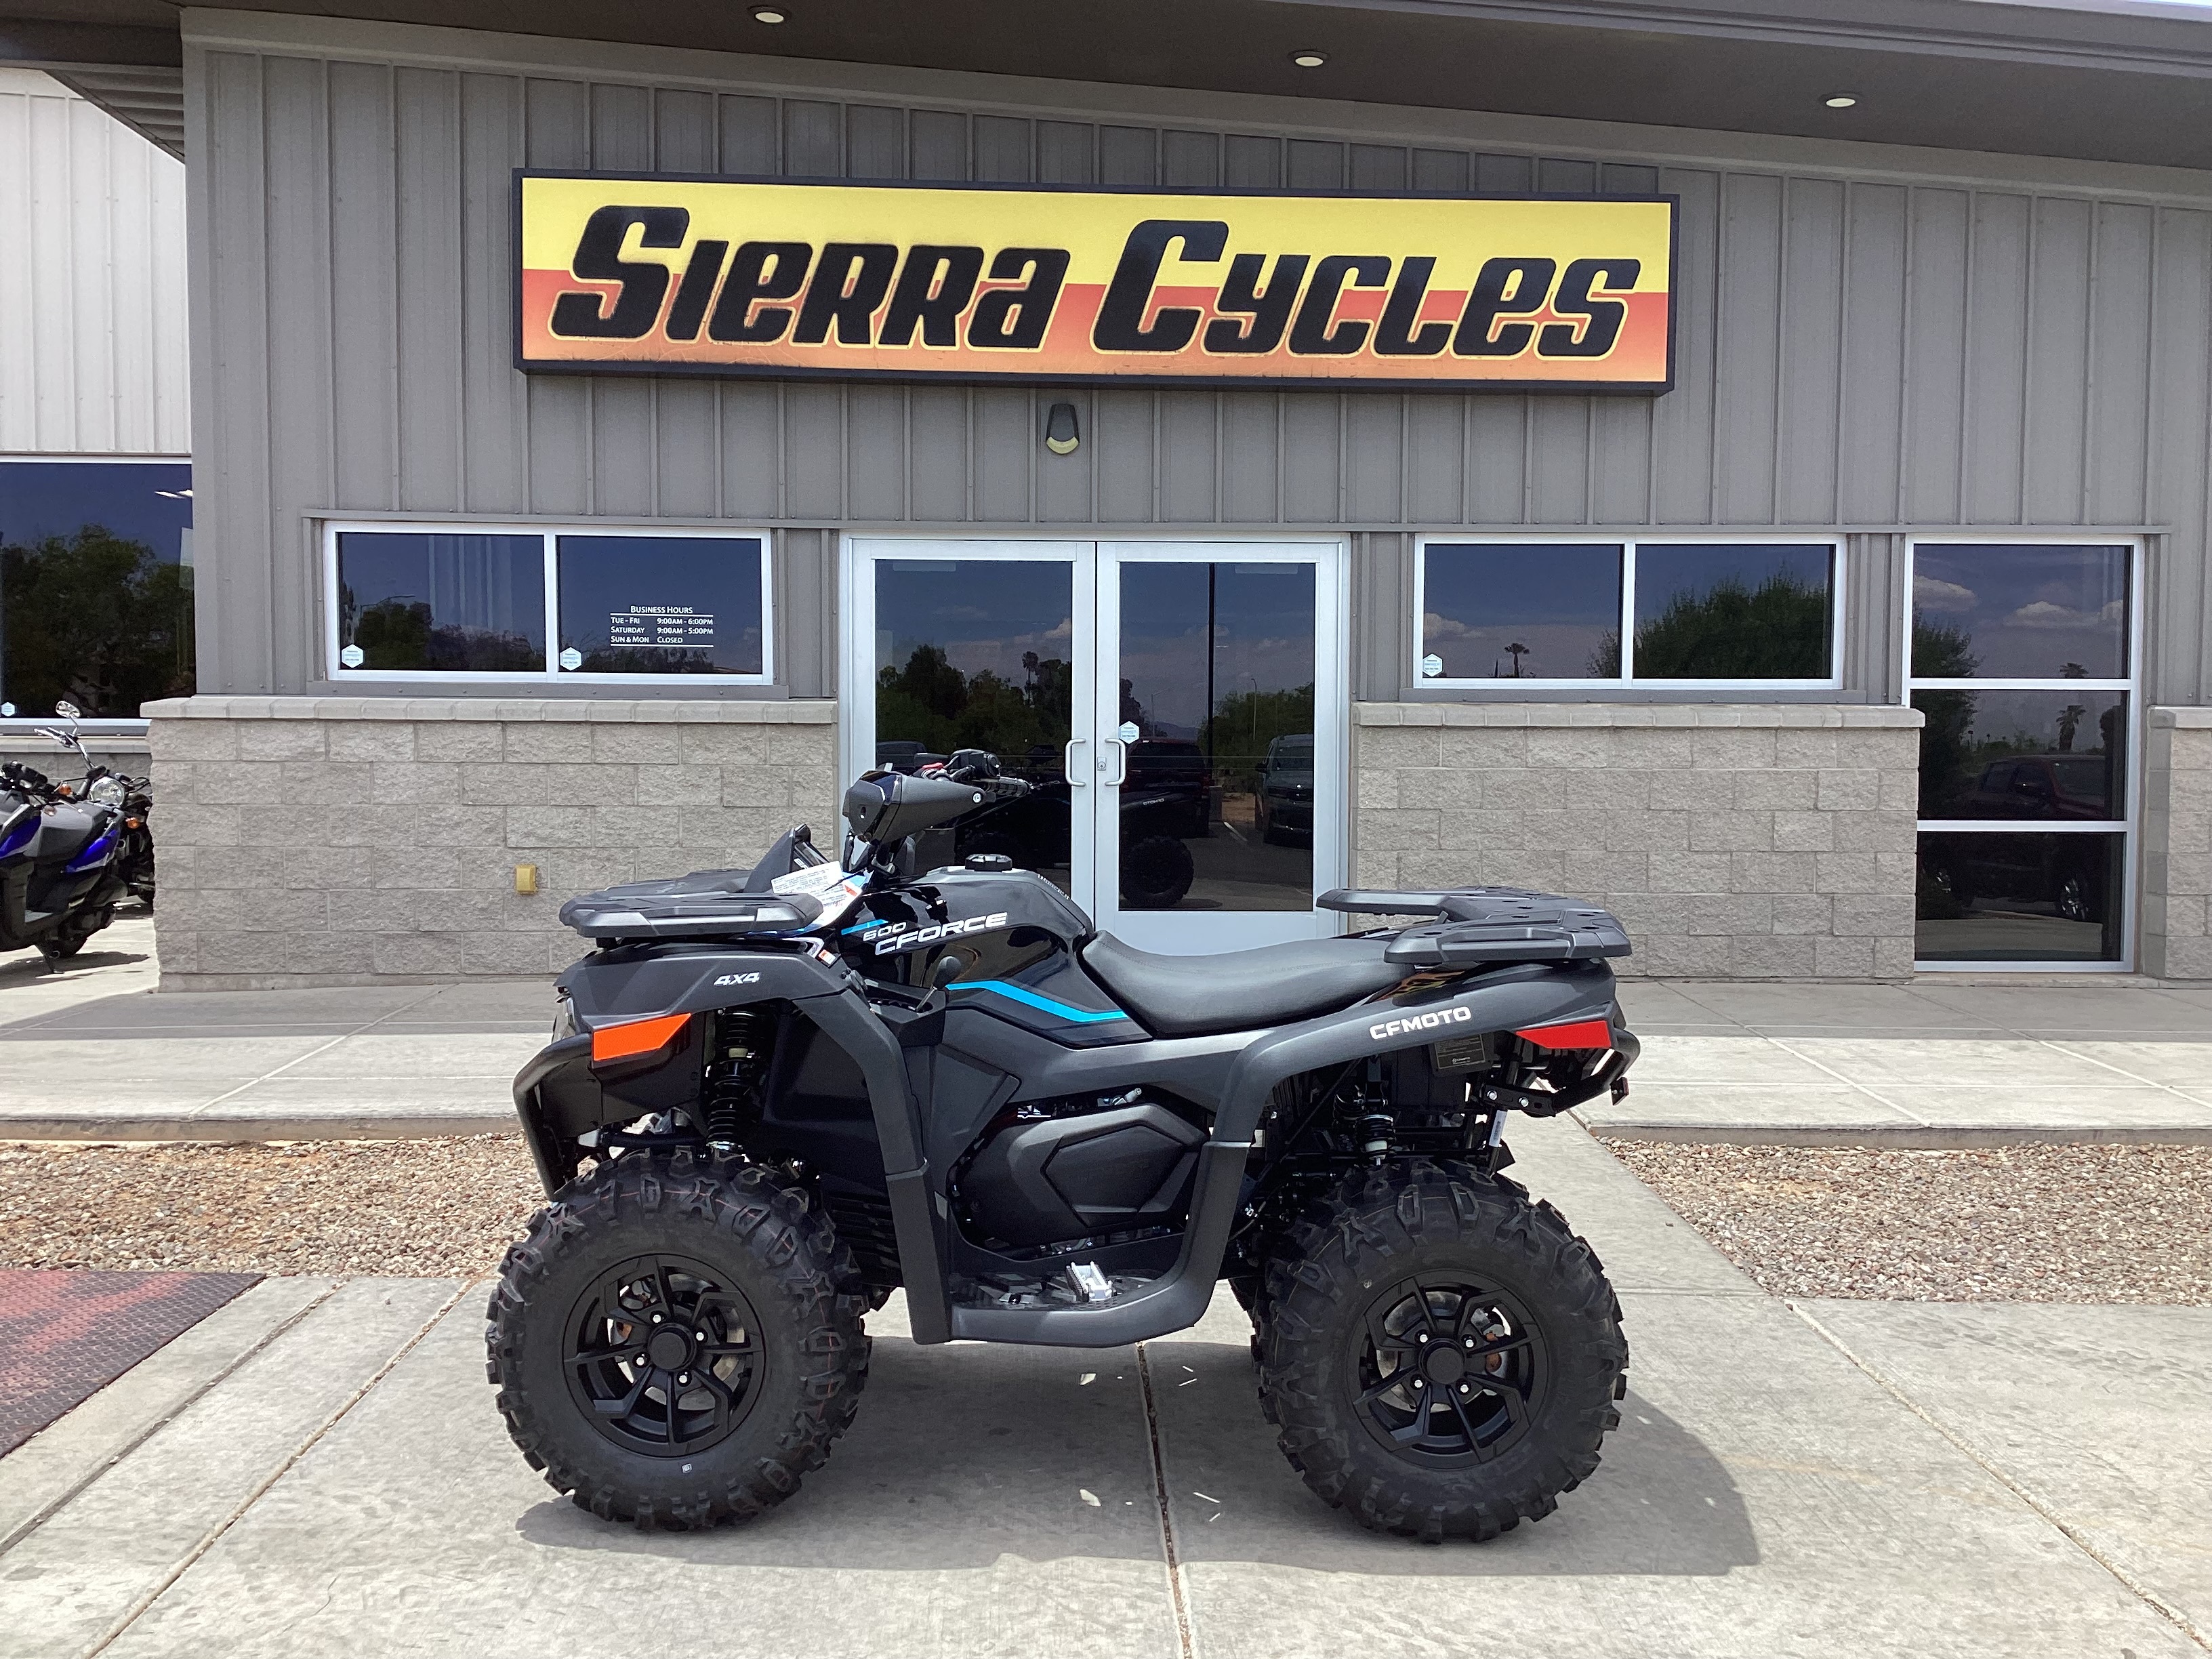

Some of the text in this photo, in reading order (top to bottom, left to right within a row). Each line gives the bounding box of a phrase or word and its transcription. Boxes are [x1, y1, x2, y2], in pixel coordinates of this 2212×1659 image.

[630, 605, 693, 614] BUSINESS HOURS
[863, 922, 907, 942] 600
[874, 912, 1008, 956] CFORCE
[1369, 1006, 1472, 1040] CFMOTO
